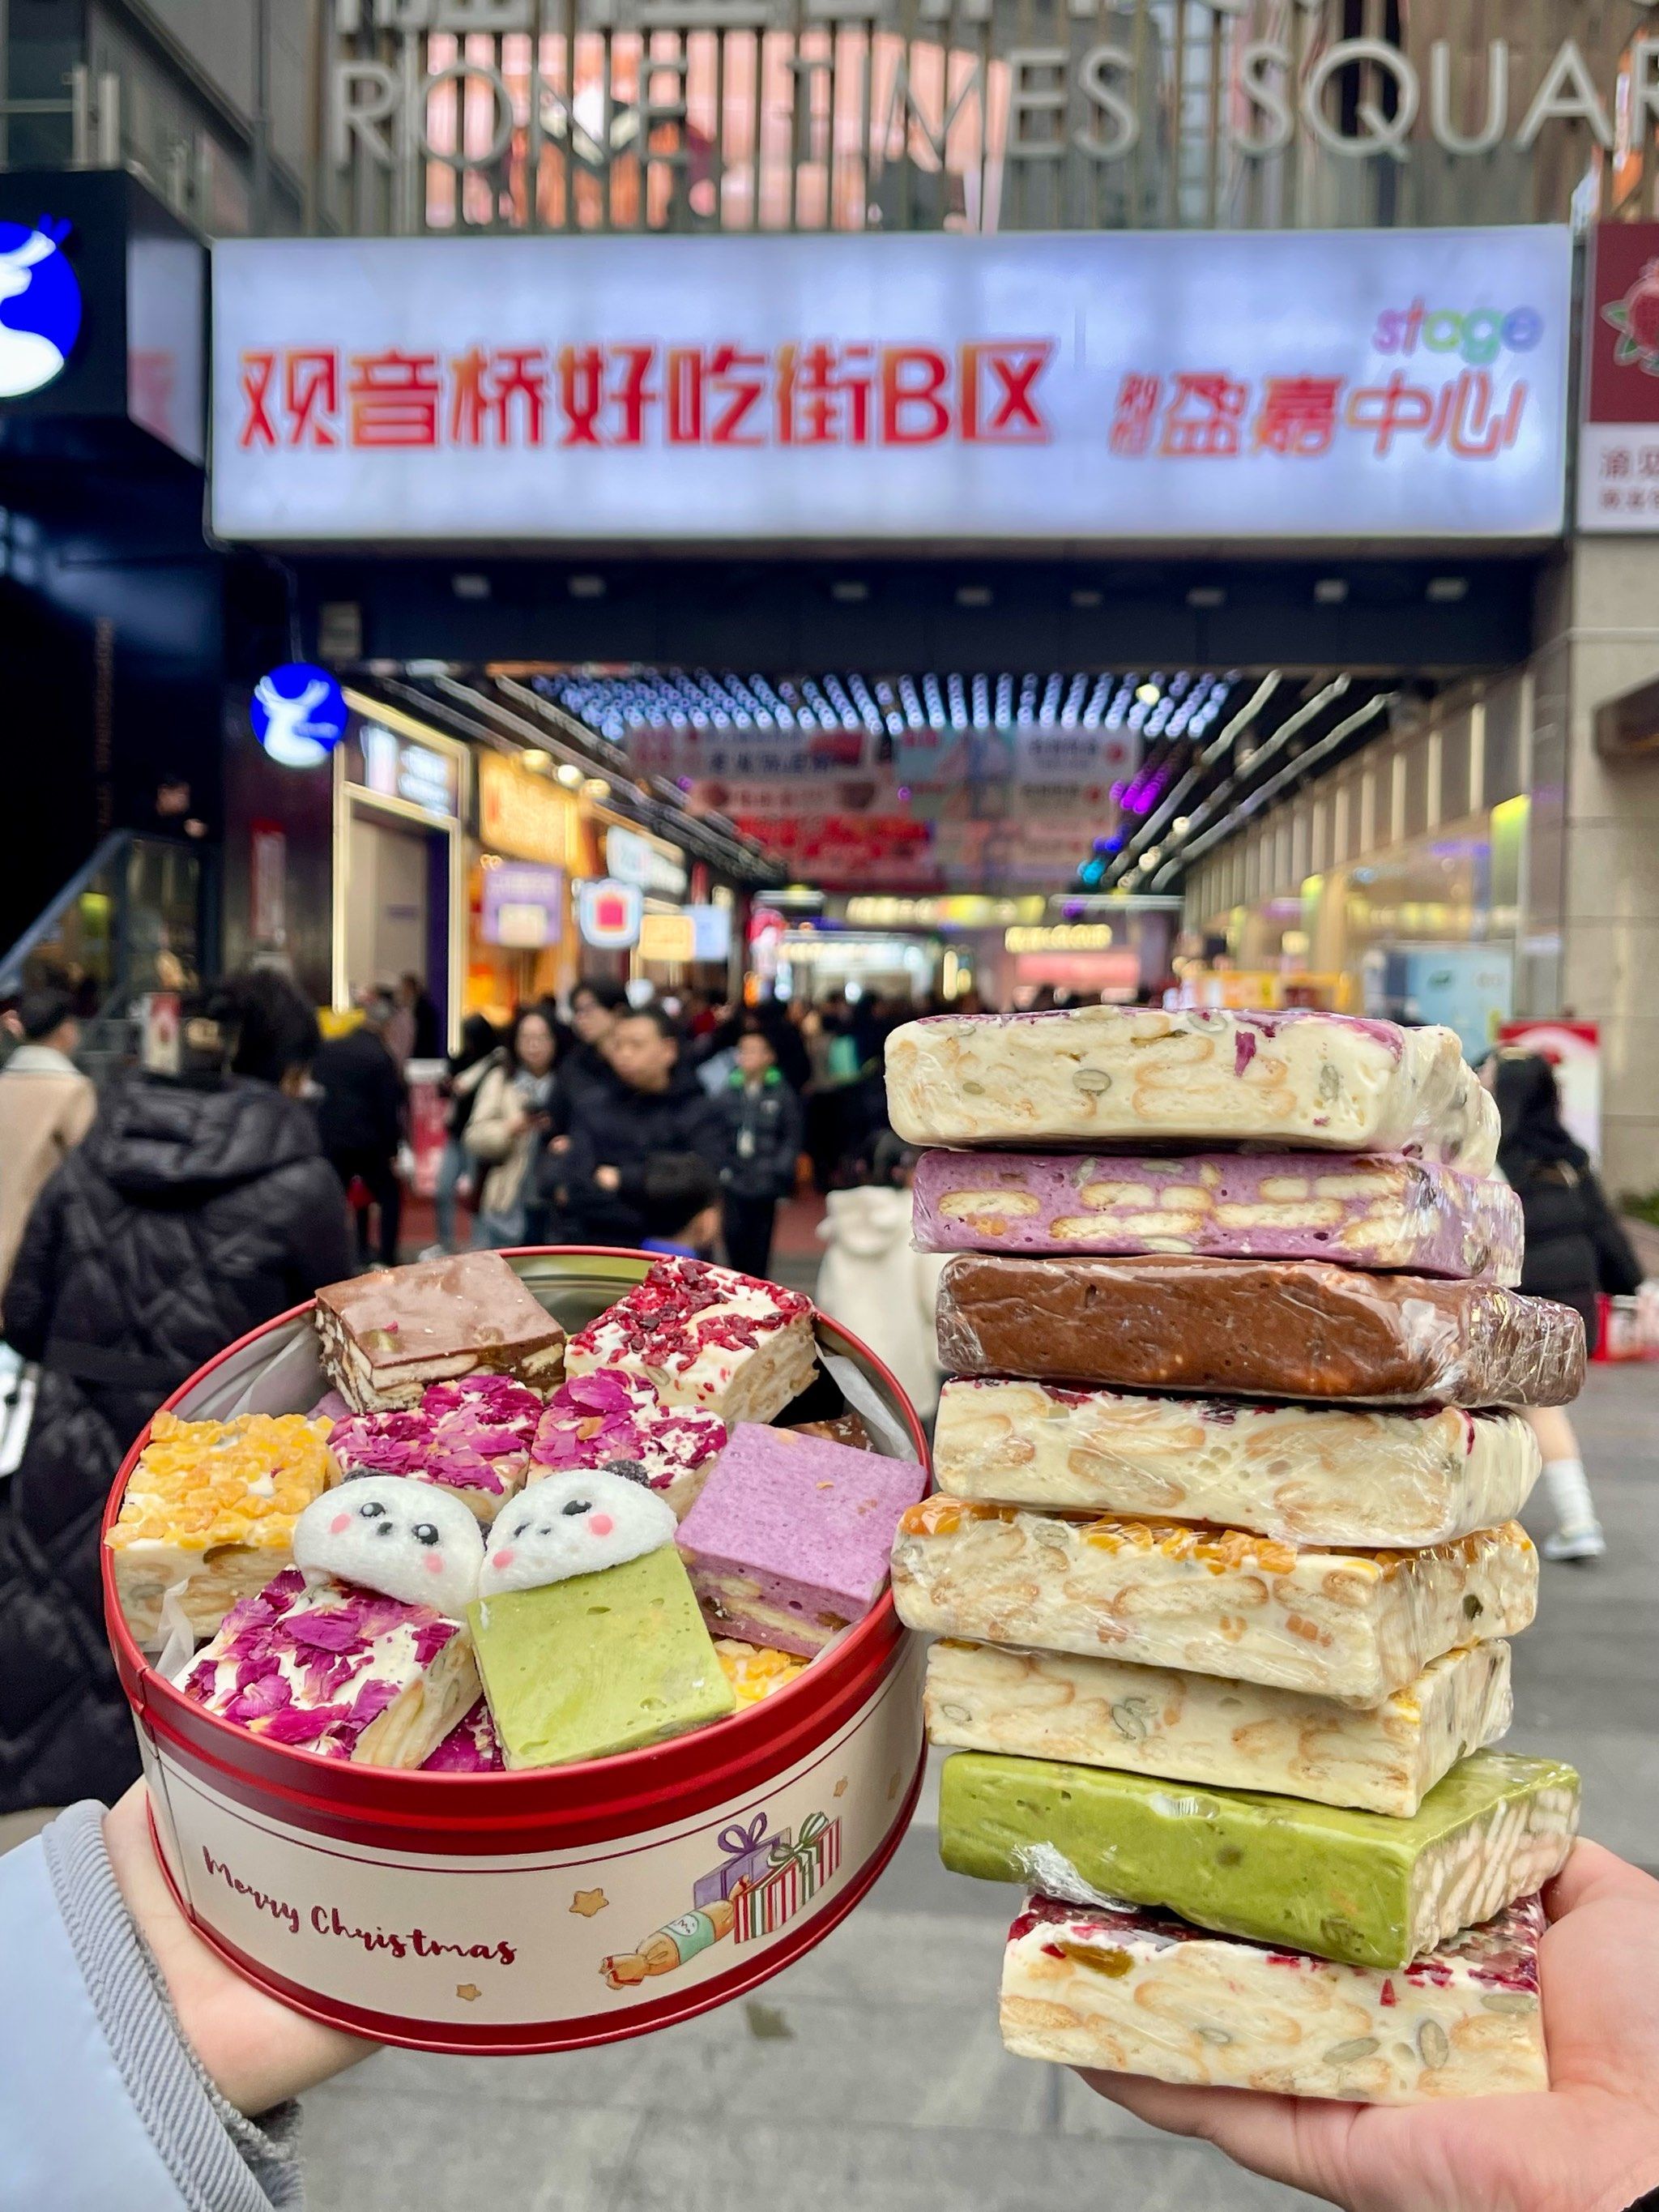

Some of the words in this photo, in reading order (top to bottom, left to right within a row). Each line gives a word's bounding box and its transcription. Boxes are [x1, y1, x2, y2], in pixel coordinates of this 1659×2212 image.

[331, 57, 689, 172] RONE
[786, 44, 1141, 172] TIMES
[239, 339, 1056, 450] 观音桥好吃街B区
[202, 1845, 300, 1934] Merry
[311, 1904, 518, 1966] Christmas
